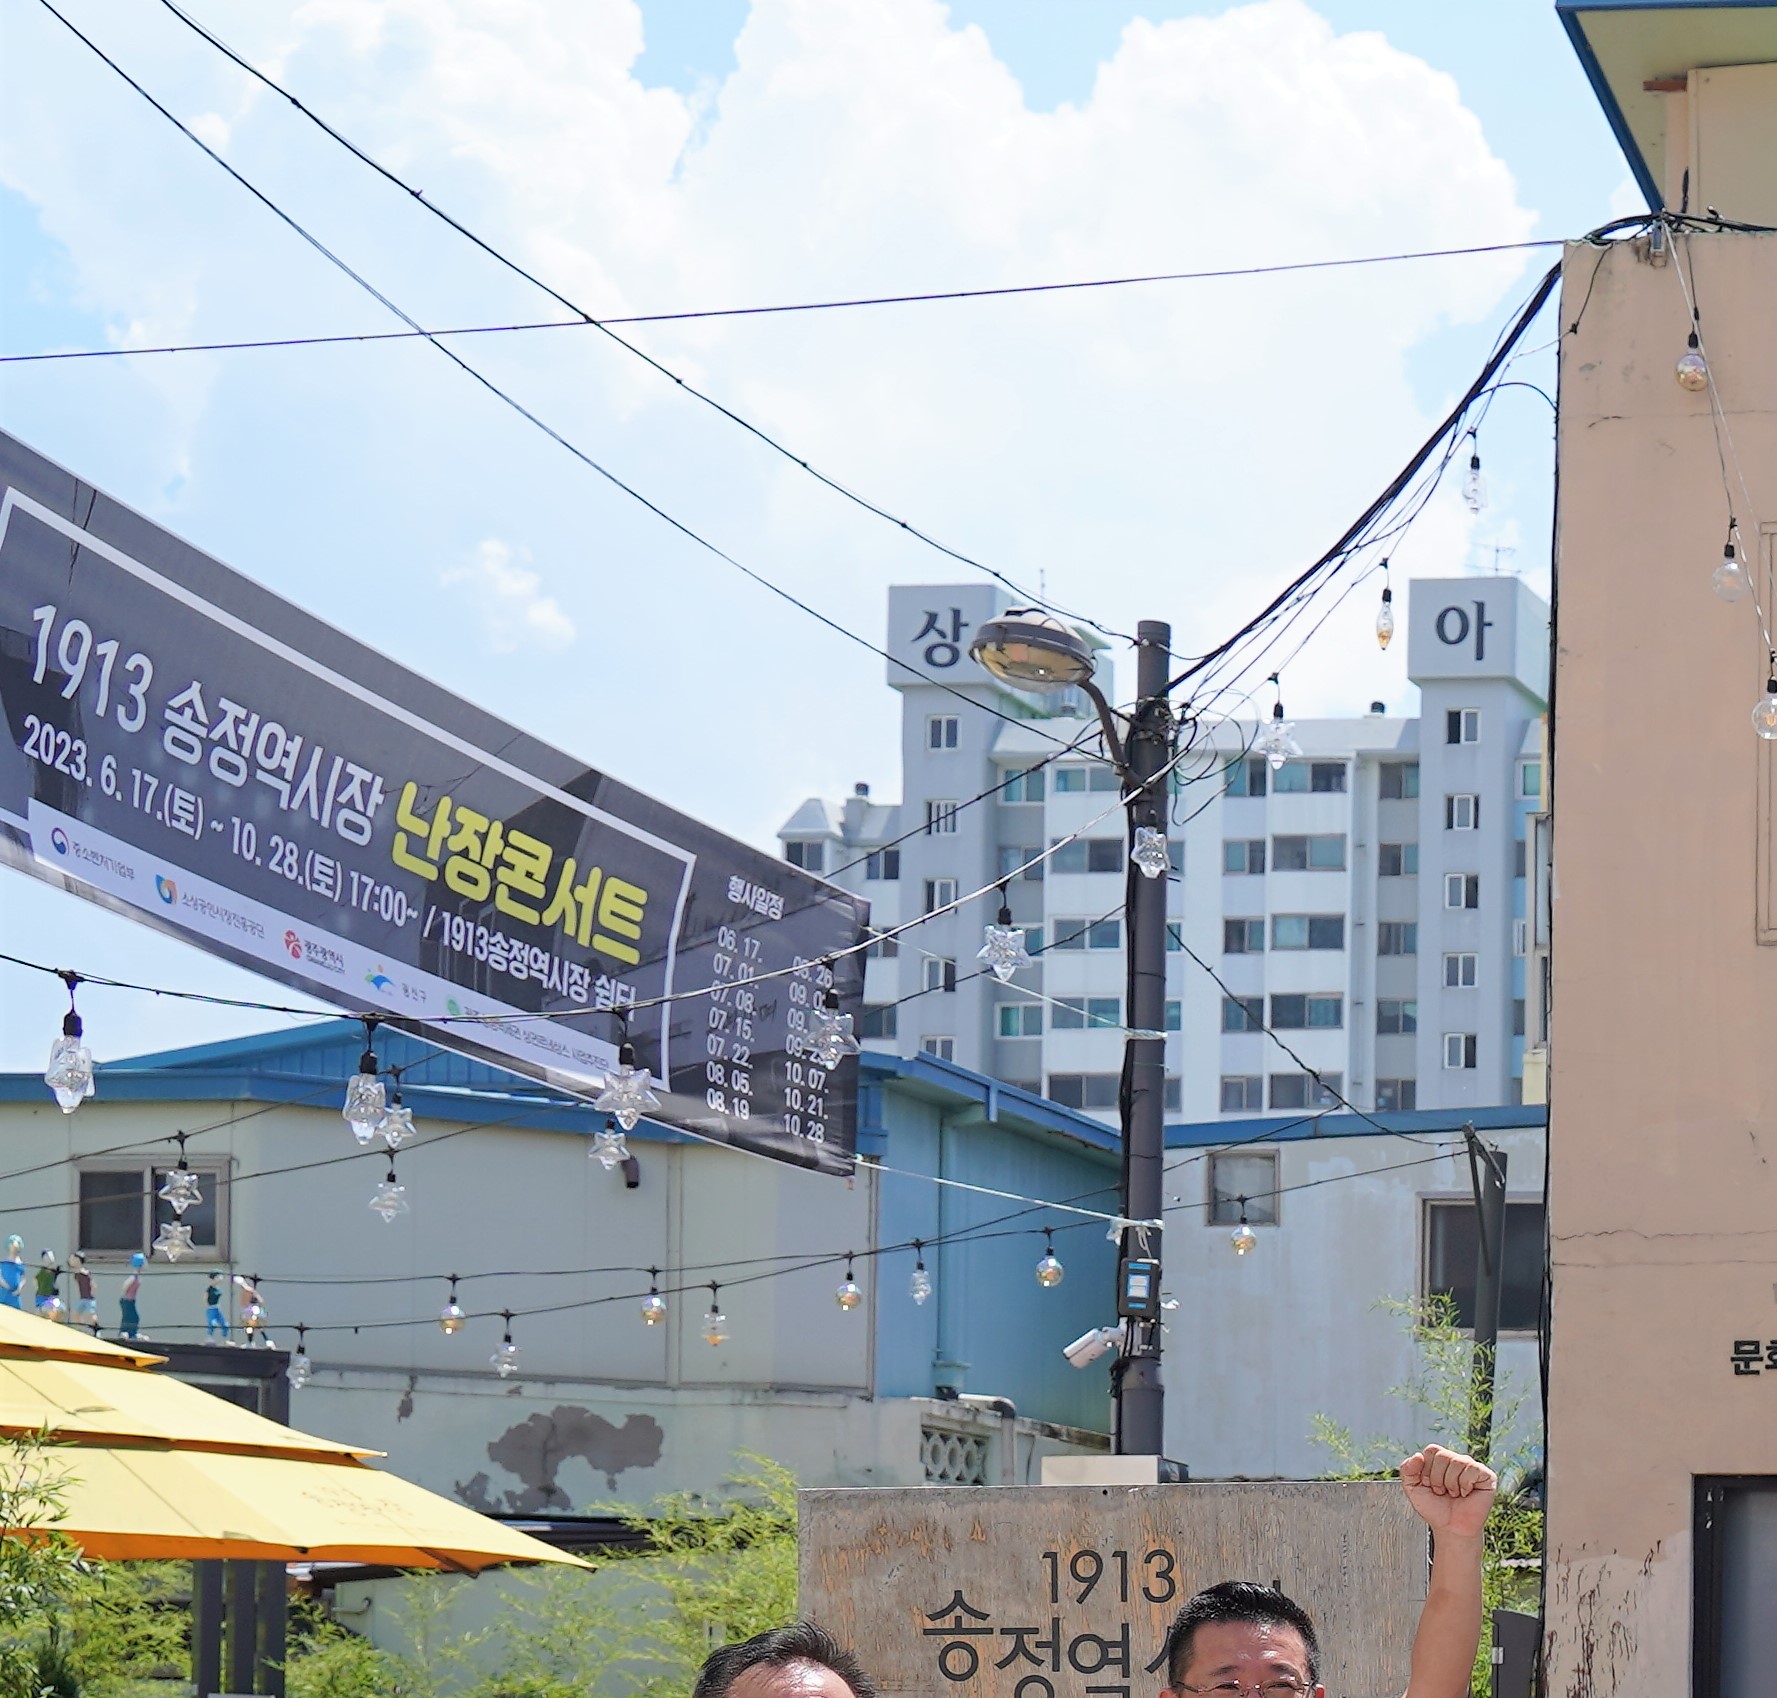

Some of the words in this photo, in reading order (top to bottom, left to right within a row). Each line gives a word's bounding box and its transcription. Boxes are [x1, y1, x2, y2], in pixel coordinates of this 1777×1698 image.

[911, 608, 969, 668] 상
[1435, 600, 1493, 661] 아
[32, 604, 154, 733] 1913
[163, 680, 385, 847] 송정역시장
[392, 780, 648, 965] 난장콘서트
[23, 714, 93, 787] 2023.
[101, 754, 122, 801] 6.
[131, 768, 204, 841] 17.(토)
[231, 816, 262, 866] 10.
[268, 834, 343, 903] 28.(토)
[442, 911, 591, 1004] 1913송정역시장
[728, 874, 785, 921] 행사일정
[1040, 1548, 1177, 1605] 1913
